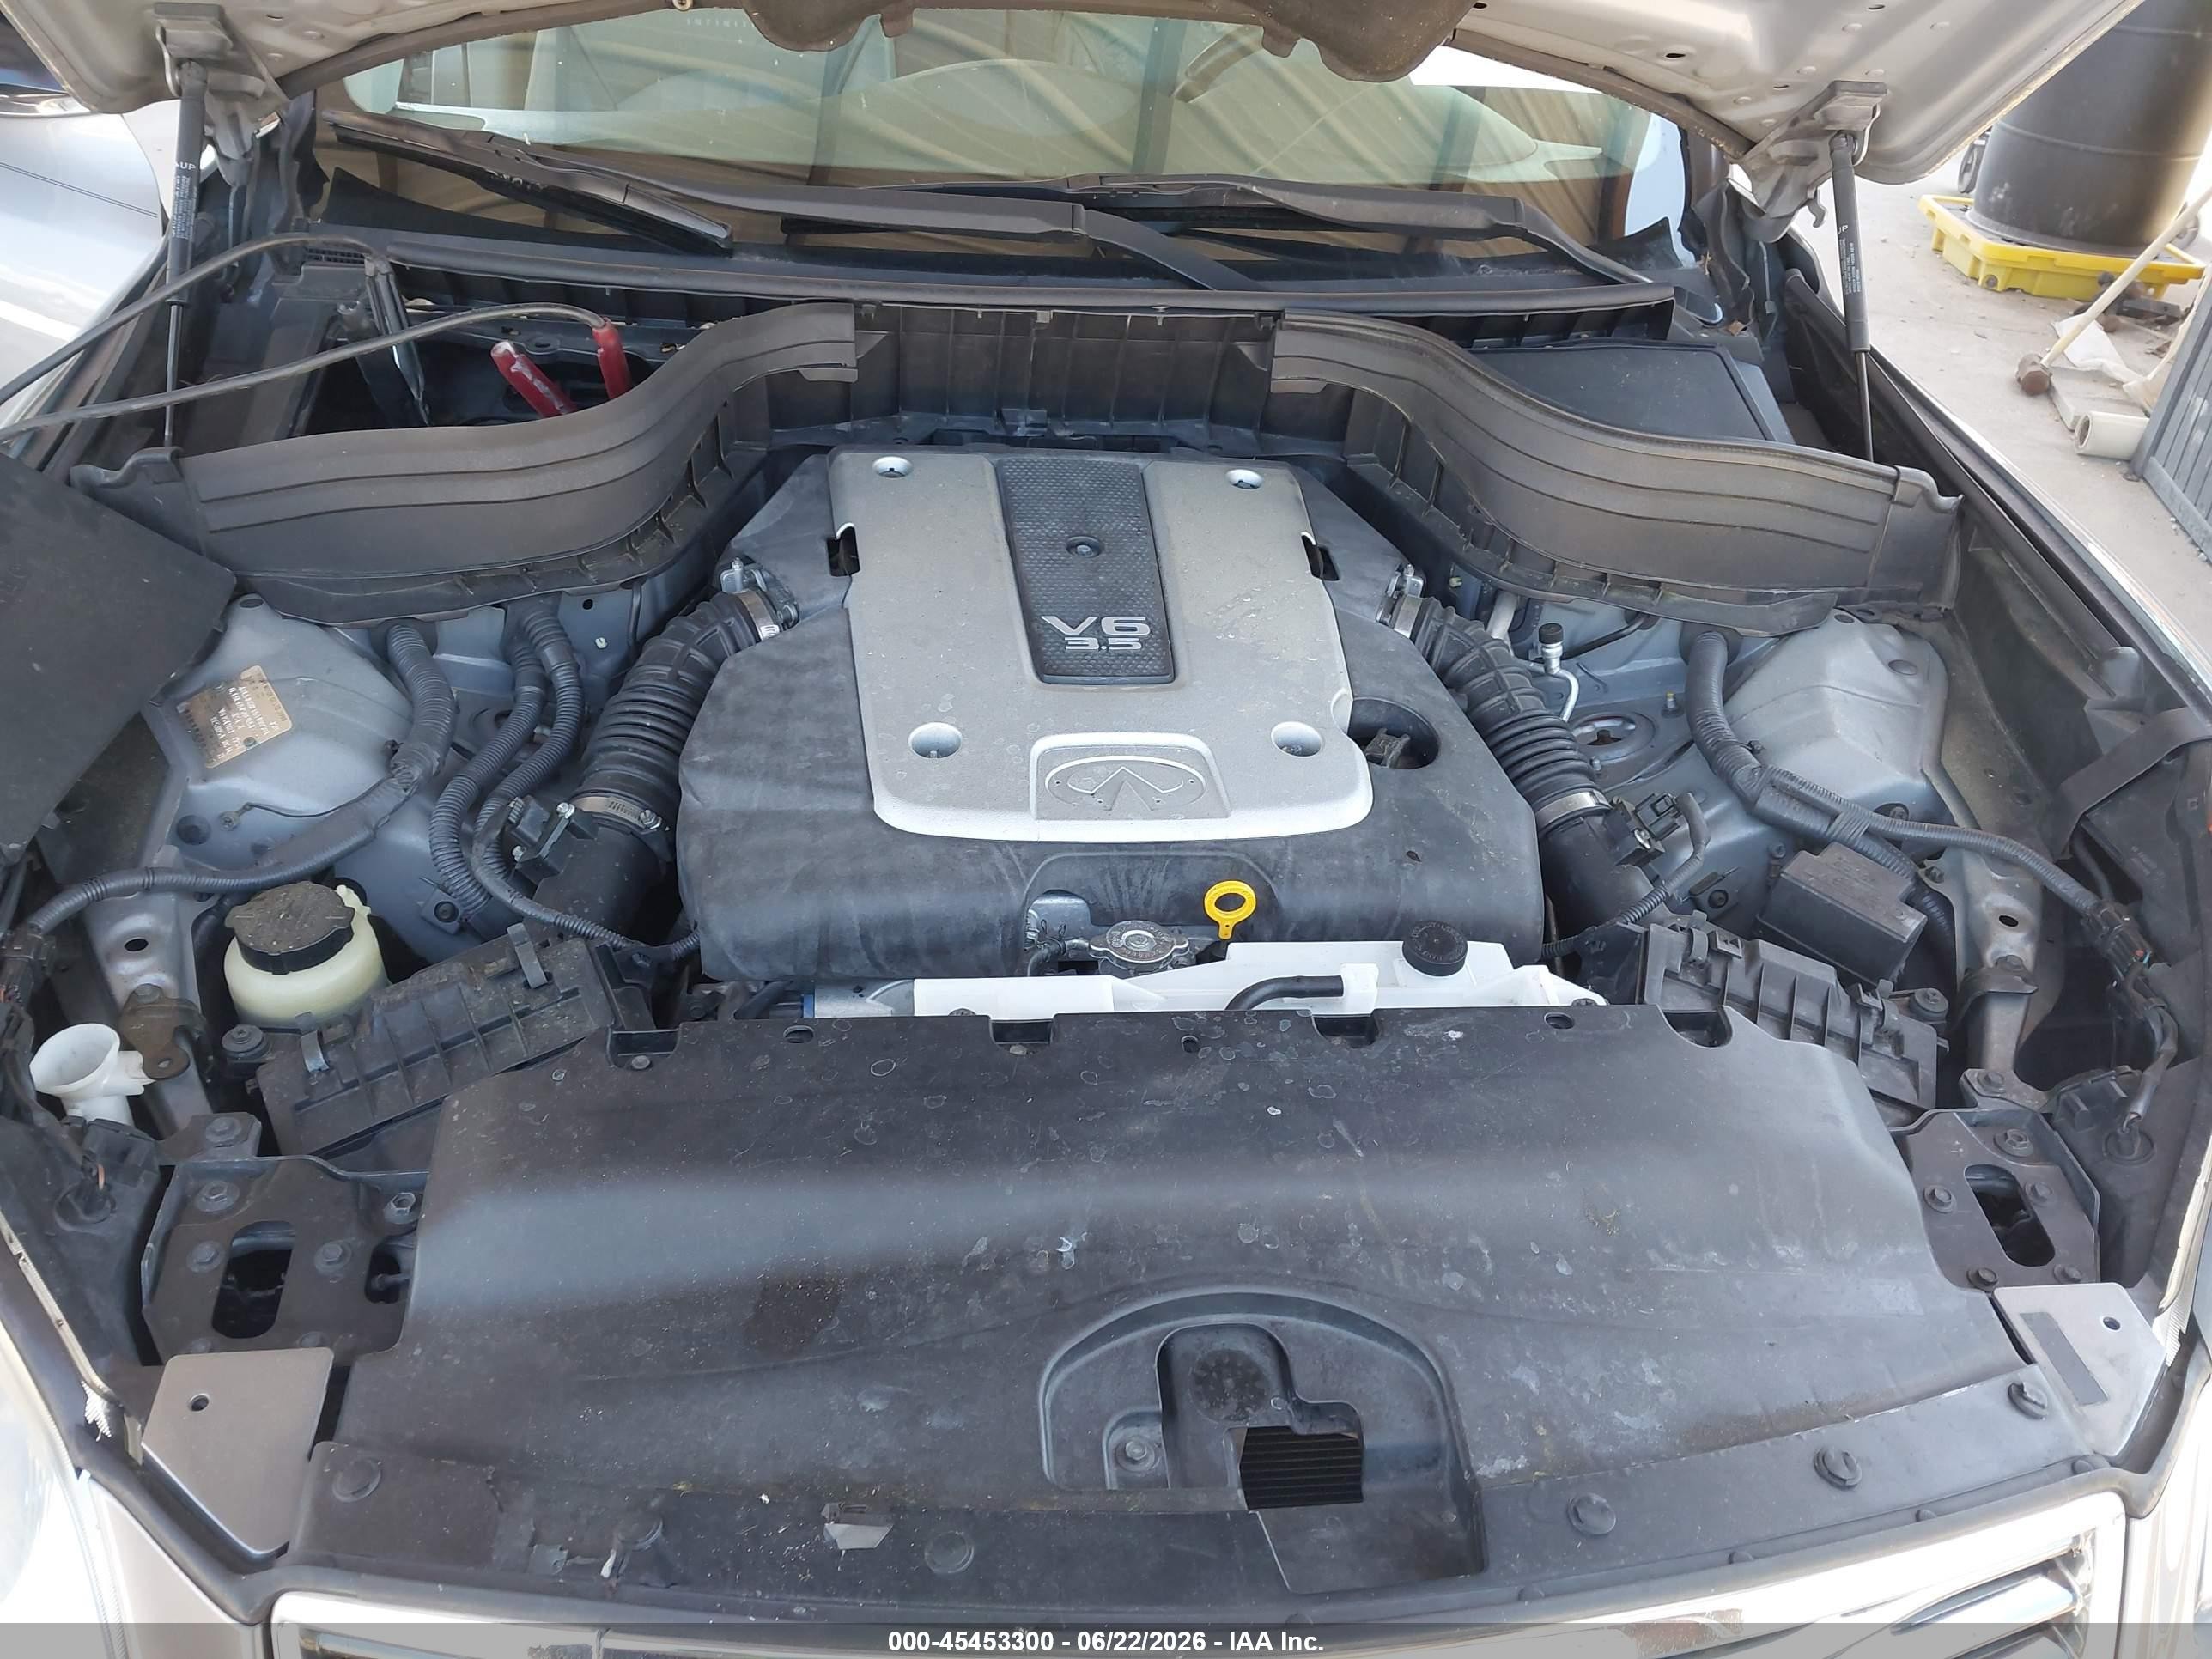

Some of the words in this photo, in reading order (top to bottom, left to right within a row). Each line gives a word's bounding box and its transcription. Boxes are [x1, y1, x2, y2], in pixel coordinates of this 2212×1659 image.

[179, 161, 197, 171] UP
[1041, 616, 1151, 635] V6
[1064, 636, 1142, 650] 3.5
